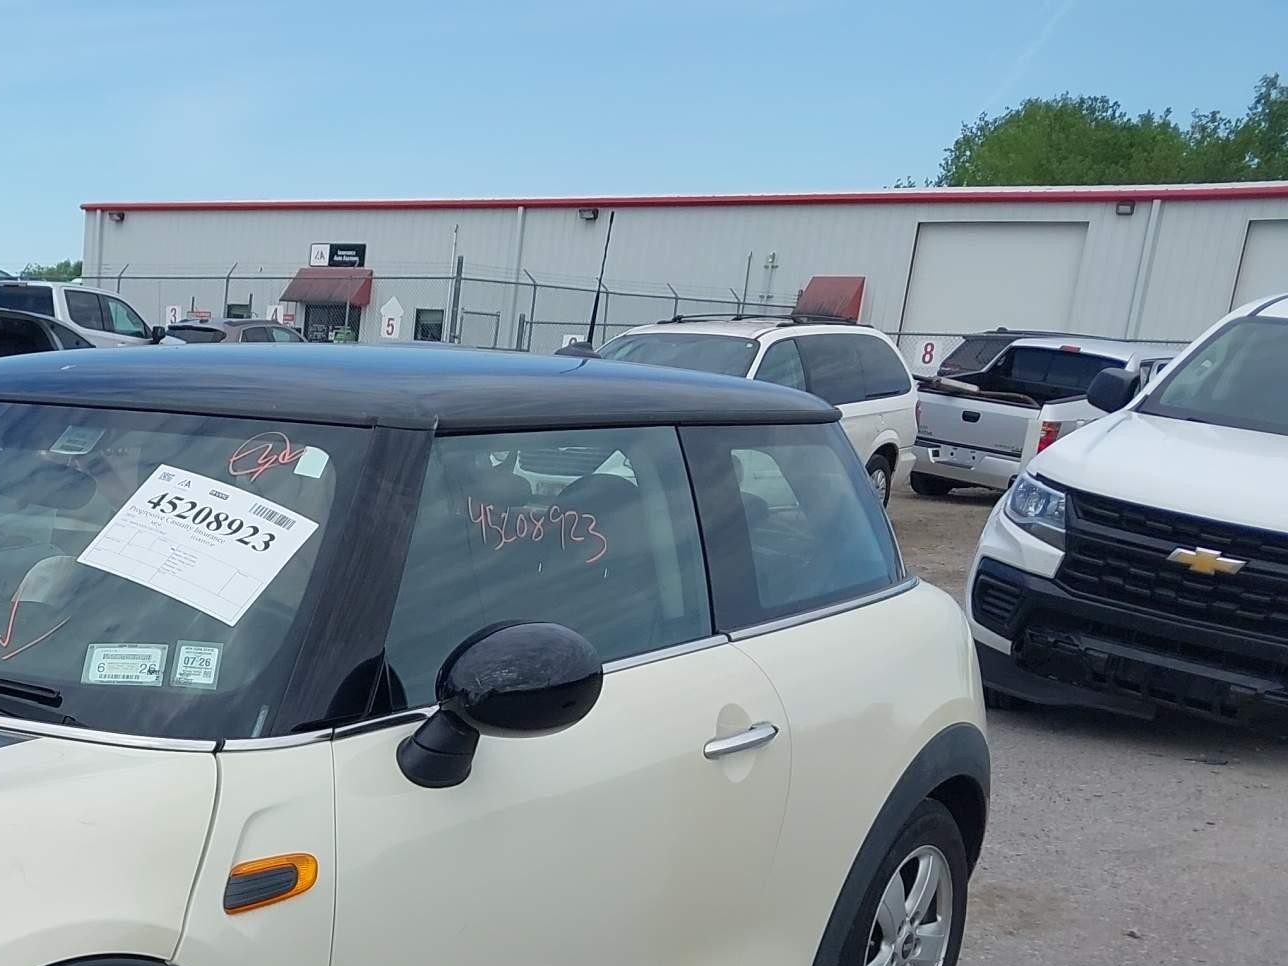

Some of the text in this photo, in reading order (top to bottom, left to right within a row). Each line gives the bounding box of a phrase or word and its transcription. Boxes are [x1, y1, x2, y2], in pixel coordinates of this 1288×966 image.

[170, 307, 177, 325] 3
[271, 306, 279, 321] 4
[385, 317, 395, 336] 5
[922, 342, 935, 365] 8
[147, 491, 276, 553] 45208923
[467, 495, 608, 563] 45208923
[194, 526, 227, 544] Insurance
[97, 662, 106, 673] 6
[183, 656, 211, 667] 07 26
